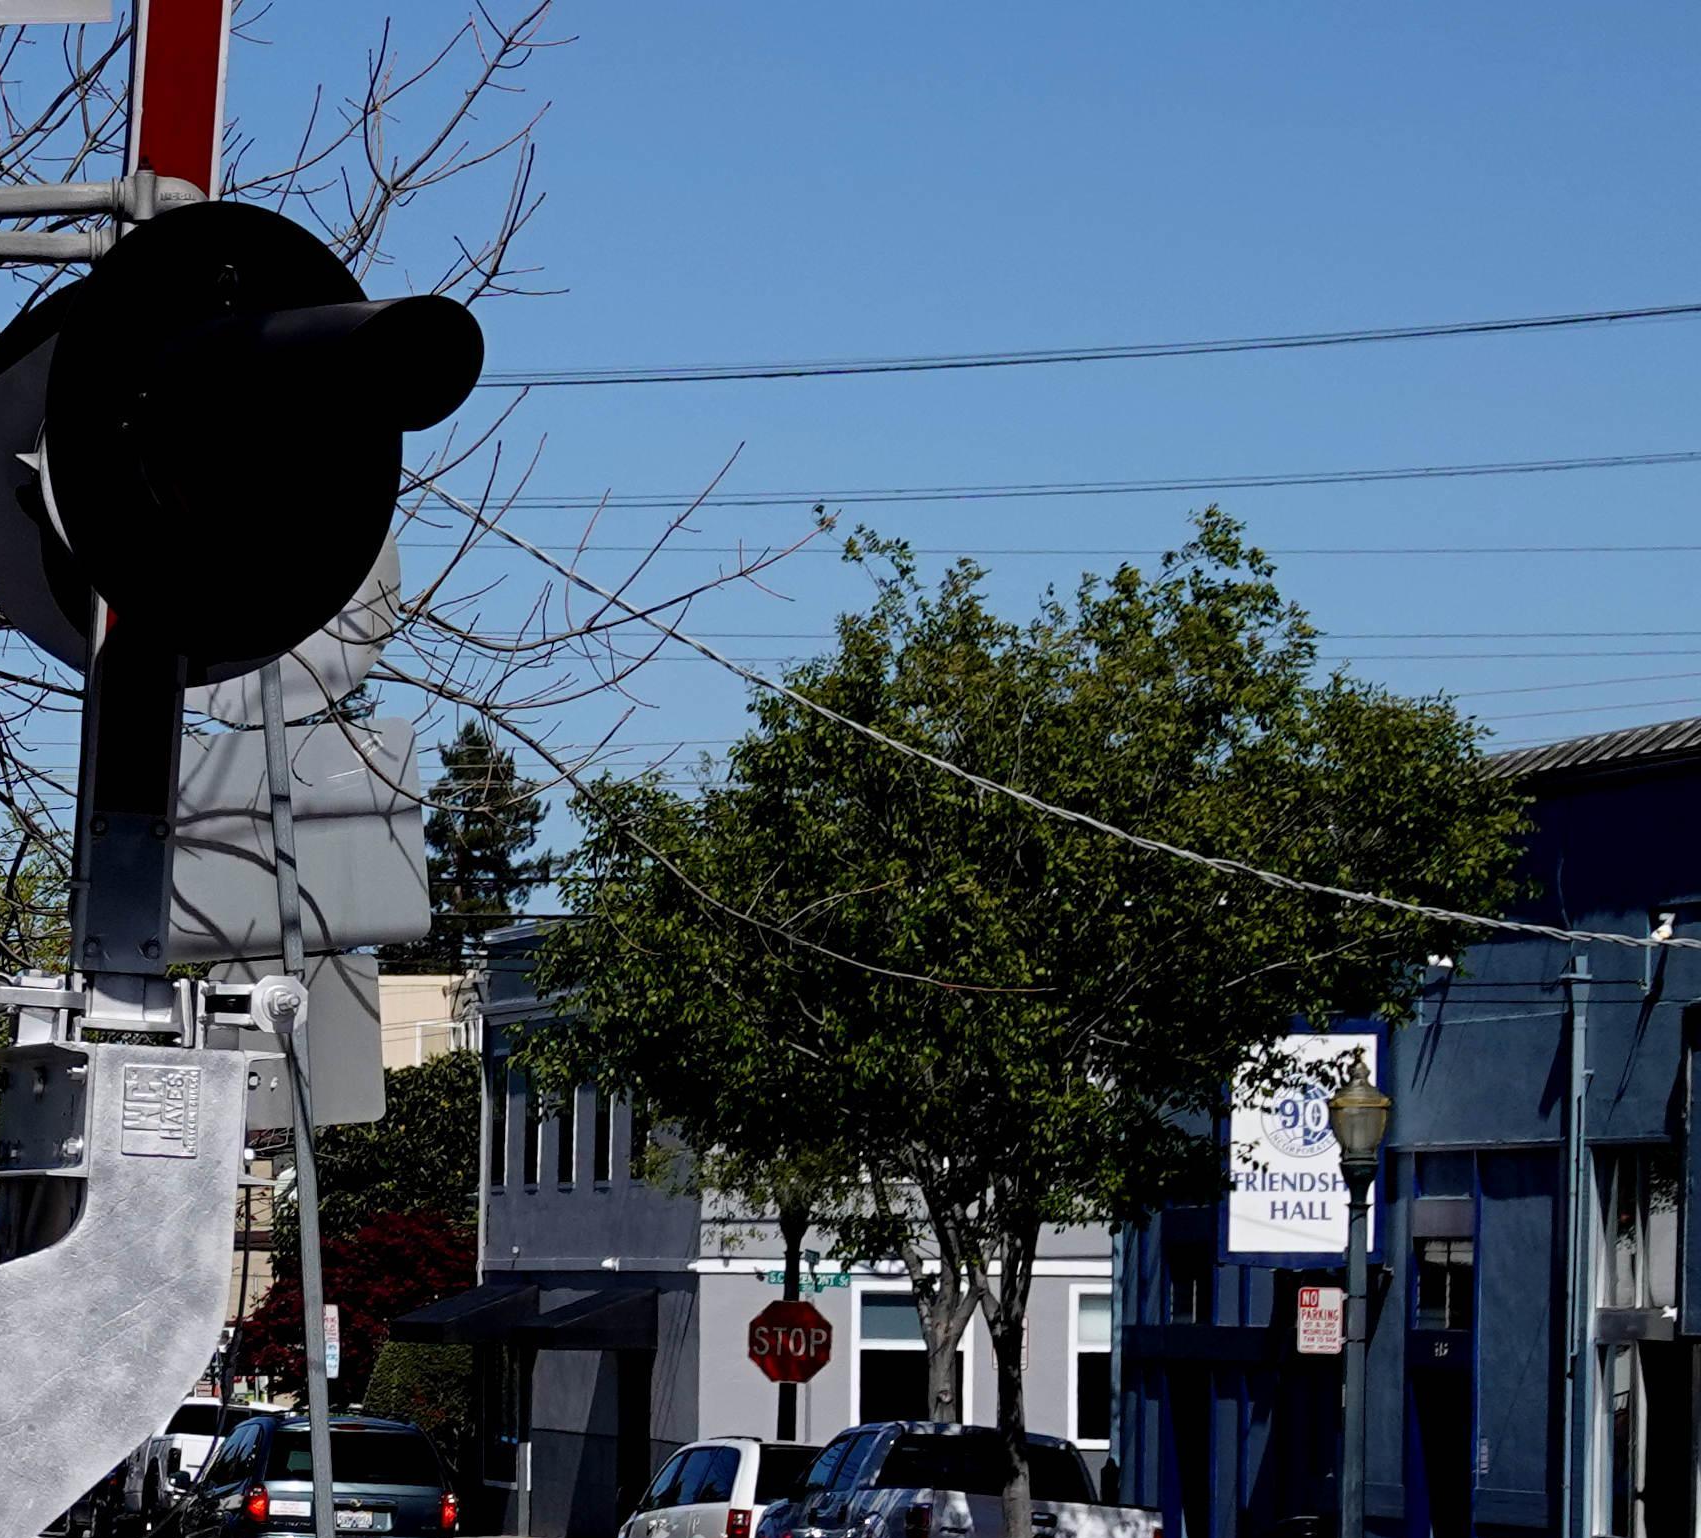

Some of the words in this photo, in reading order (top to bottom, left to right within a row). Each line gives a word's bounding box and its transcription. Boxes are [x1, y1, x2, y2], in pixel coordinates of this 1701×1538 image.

[1232, 1172, 1349, 1193] FRIENDSH
[1270, 1201, 1332, 1221] HALL
[1302, 1291, 1318, 1306] NO
[1301, 1309, 1339, 1321] PARKING
[753, 1326, 828, 1358] STOP
